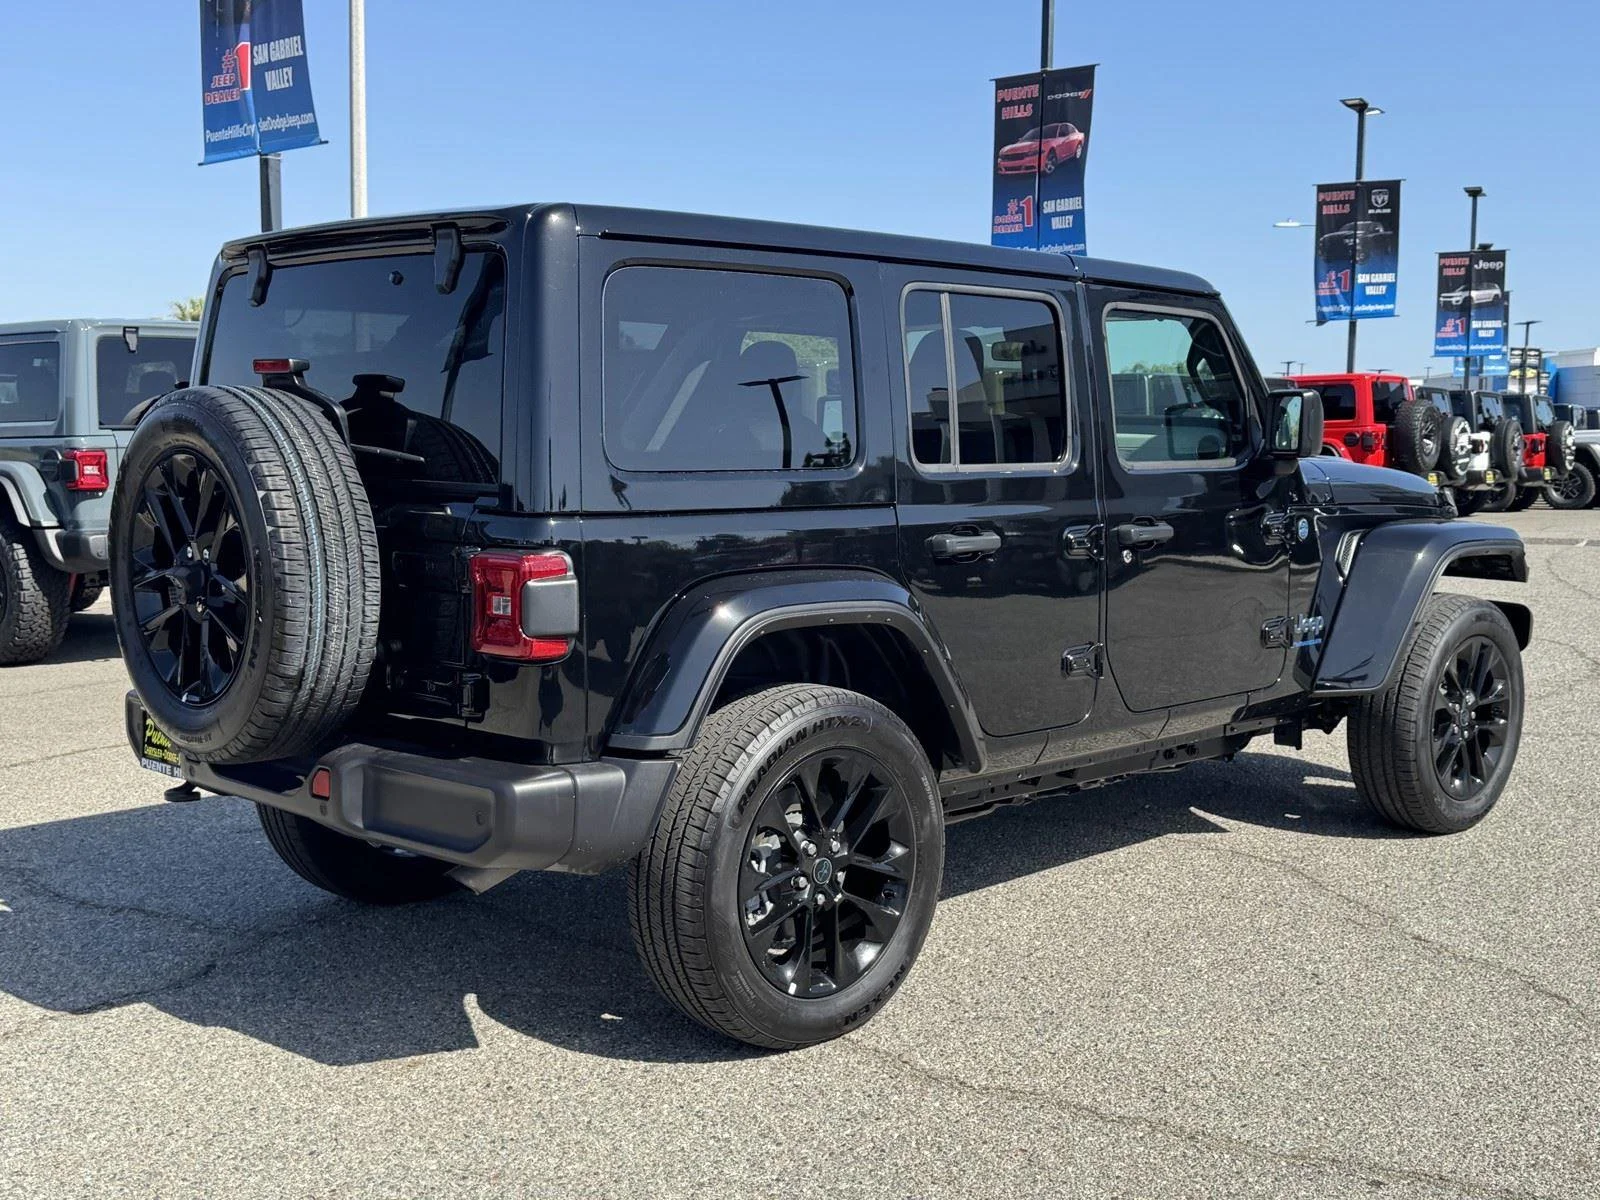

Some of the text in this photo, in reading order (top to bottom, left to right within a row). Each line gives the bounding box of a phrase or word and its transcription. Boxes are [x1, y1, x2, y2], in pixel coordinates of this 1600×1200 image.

[253, 35, 303, 65] SAN GABRIEL
[211, 73, 235, 88] JEEP
[264, 66, 293, 92] VALLEY
[996, 83, 1040, 103] PUENTE
[1001, 103, 1033, 120] HILLS
[1042, 196, 1083, 214] SAN GABRIEL
[1318, 190, 1356, 202] PUENTE
[1322, 203, 1351, 215] HILLS
[1051, 215, 1074, 230] VALLEY
[1474, 259, 1504, 271] Jeep
[1294, 613, 1325, 635] Jeep
[141, 756, 172, 775] PUENTE
[736, 726, 809, 815] ROADIAN
